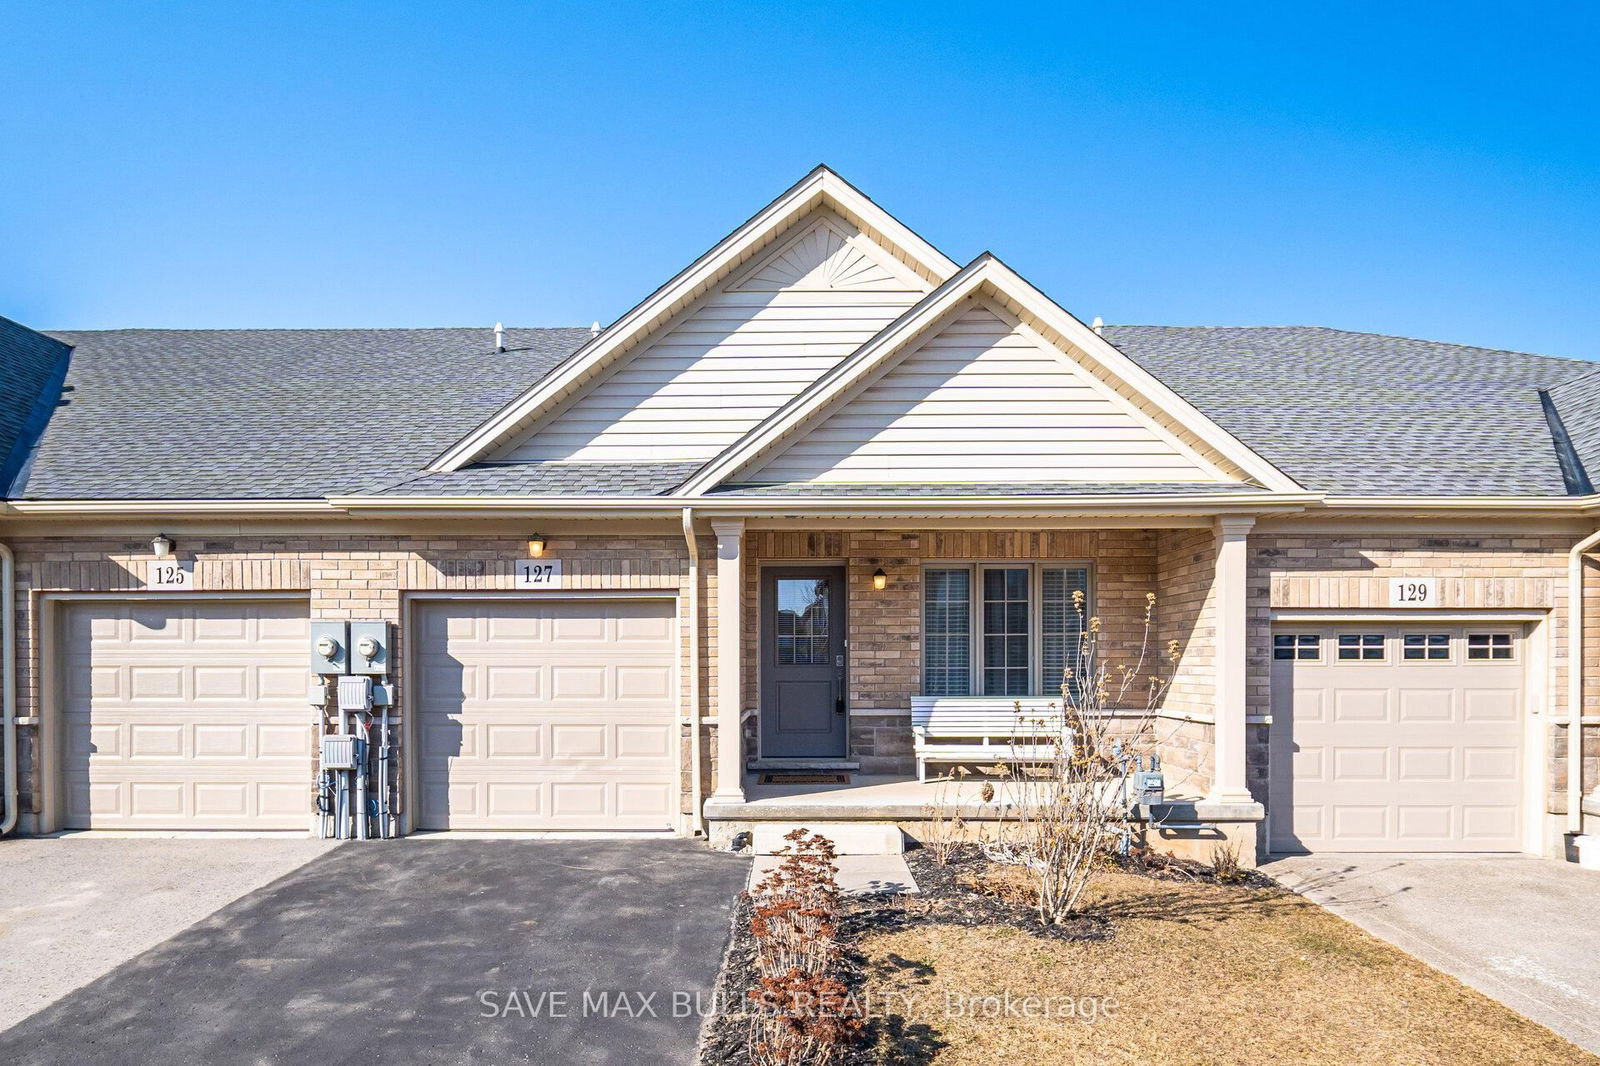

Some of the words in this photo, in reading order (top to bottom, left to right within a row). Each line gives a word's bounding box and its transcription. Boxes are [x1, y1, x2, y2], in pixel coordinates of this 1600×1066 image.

[156, 566, 184, 584] 125
[523, 565, 553, 583] 127
[1398, 583, 1427, 601] 129
